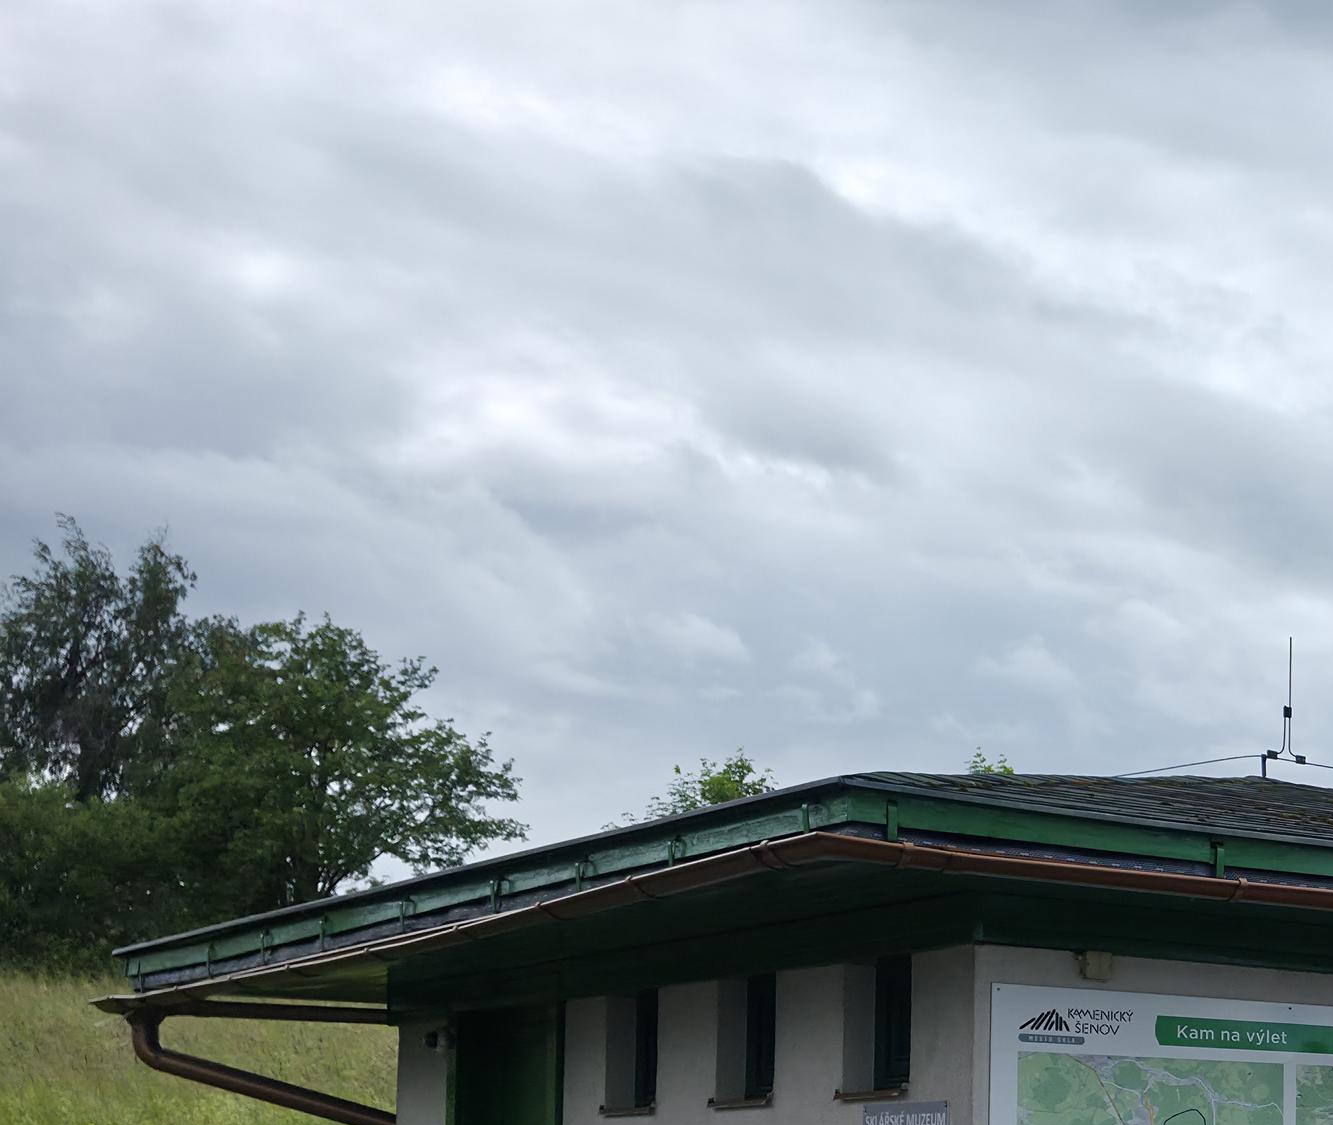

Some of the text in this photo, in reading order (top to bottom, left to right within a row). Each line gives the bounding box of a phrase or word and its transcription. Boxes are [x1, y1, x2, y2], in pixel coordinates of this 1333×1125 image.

[1067, 1008, 1133, 1023] KAMENICKÝ
[1074, 1021, 1120, 1036] ŠENOV
[1176, 1024, 1287, 1046] Kam na výlet
